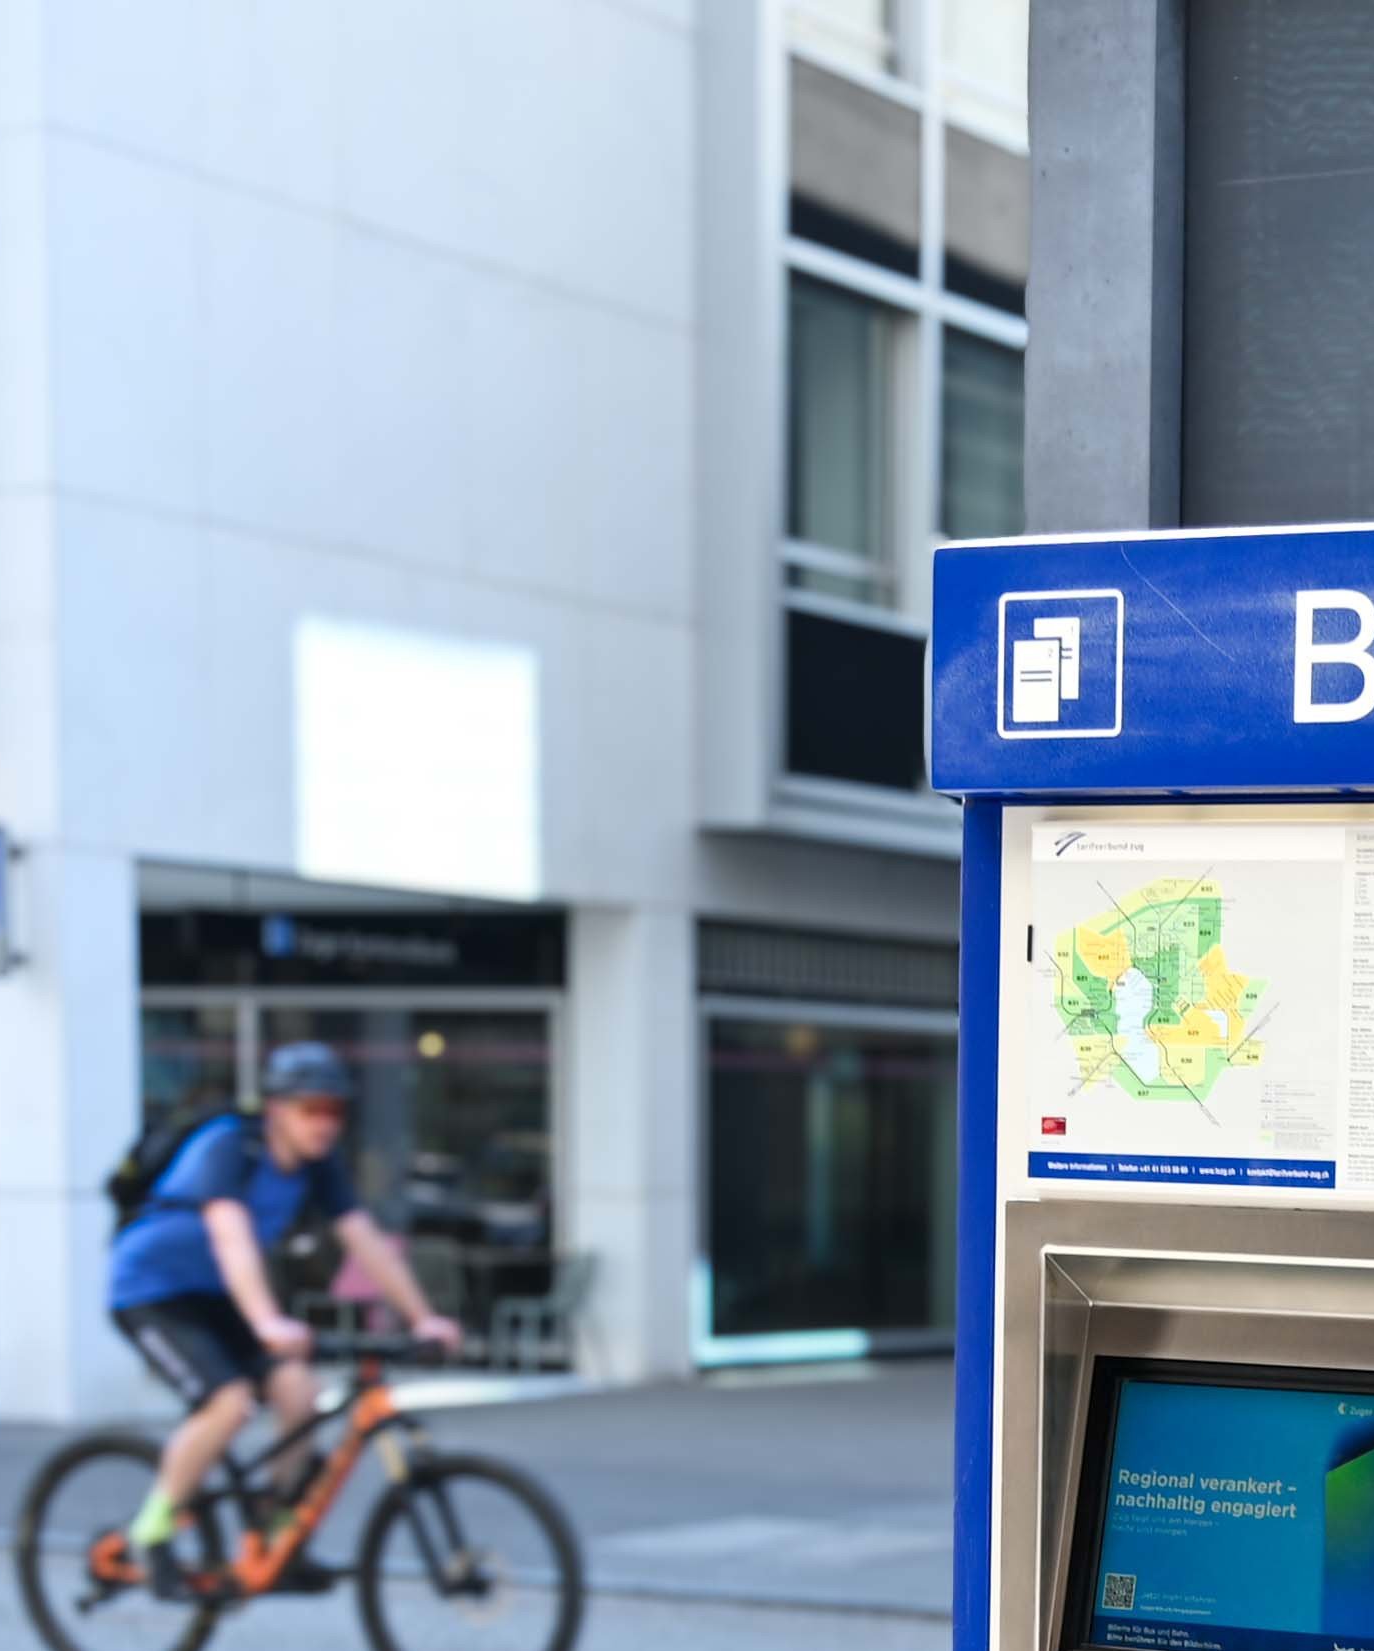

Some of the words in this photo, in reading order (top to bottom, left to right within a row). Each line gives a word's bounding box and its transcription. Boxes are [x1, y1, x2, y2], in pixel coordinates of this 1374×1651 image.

[1118, 1469, 1194, 1488] Regional
[1200, 1477, 1282, 1496] verankert
[1115, 1492, 1205, 1514] nachhaltig
[1211, 1500, 1297, 1519] engagiert
